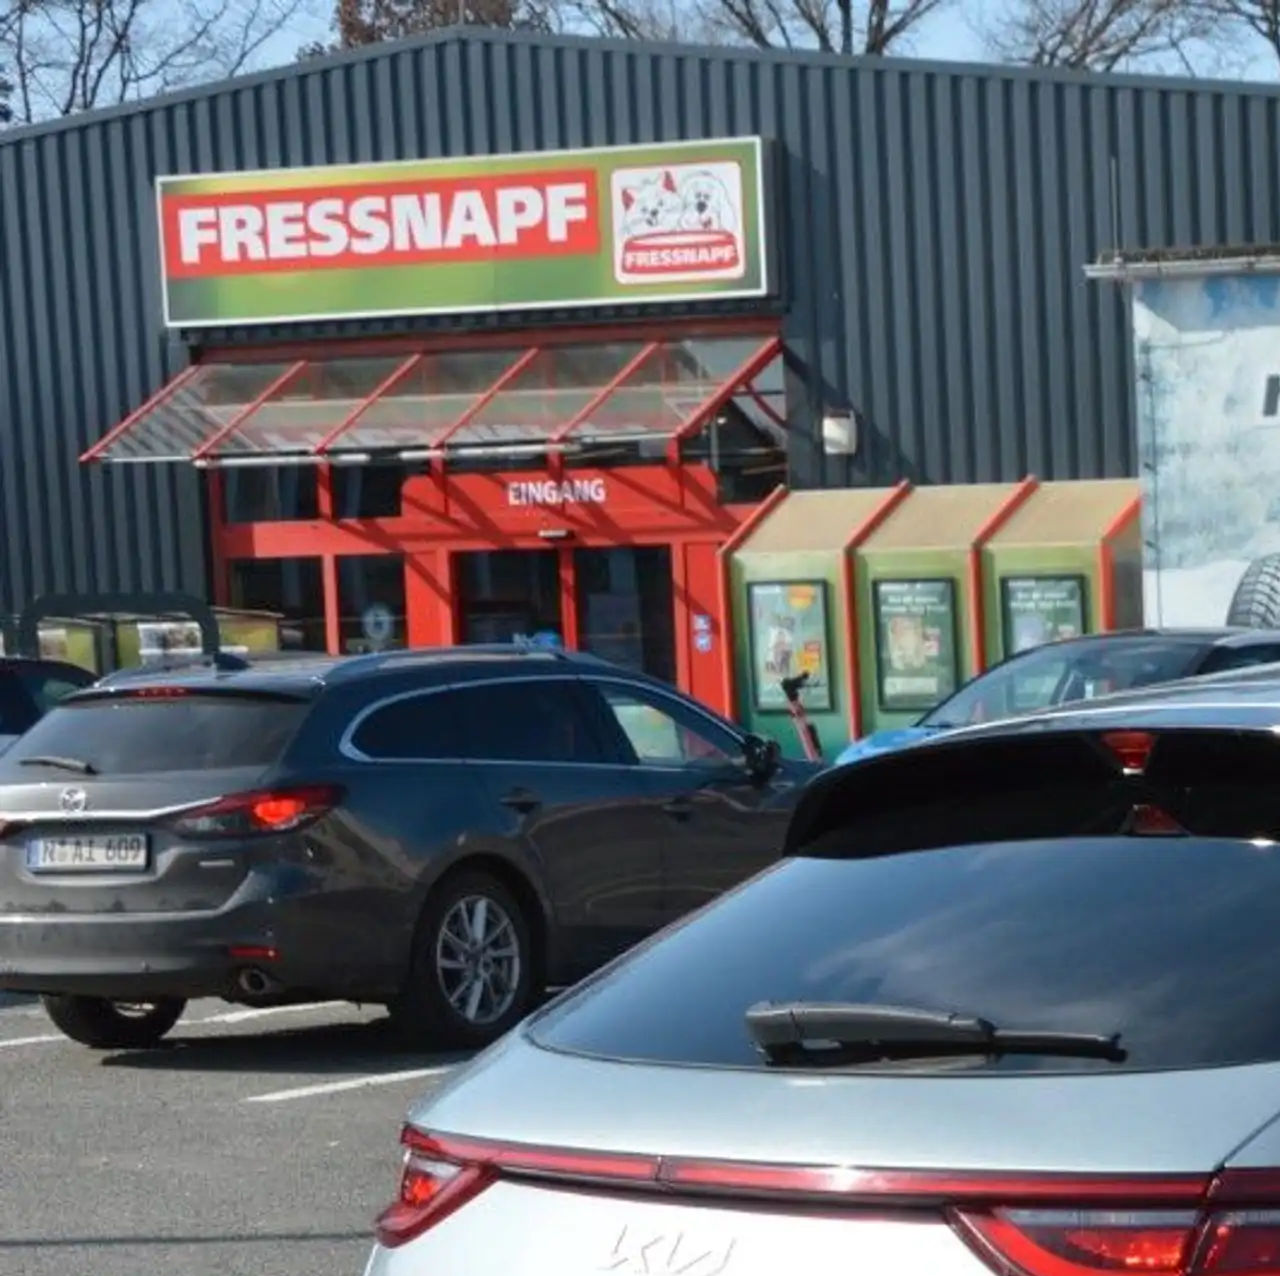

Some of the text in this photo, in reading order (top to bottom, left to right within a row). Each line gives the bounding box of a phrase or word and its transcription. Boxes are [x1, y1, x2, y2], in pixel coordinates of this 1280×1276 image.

[178, 181, 588, 264] FRESSNAPF
[625, 245, 735, 268] FRESSNAPF
[508, 479, 606, 506] EINGANG
[43, 840, 55, 863] N
